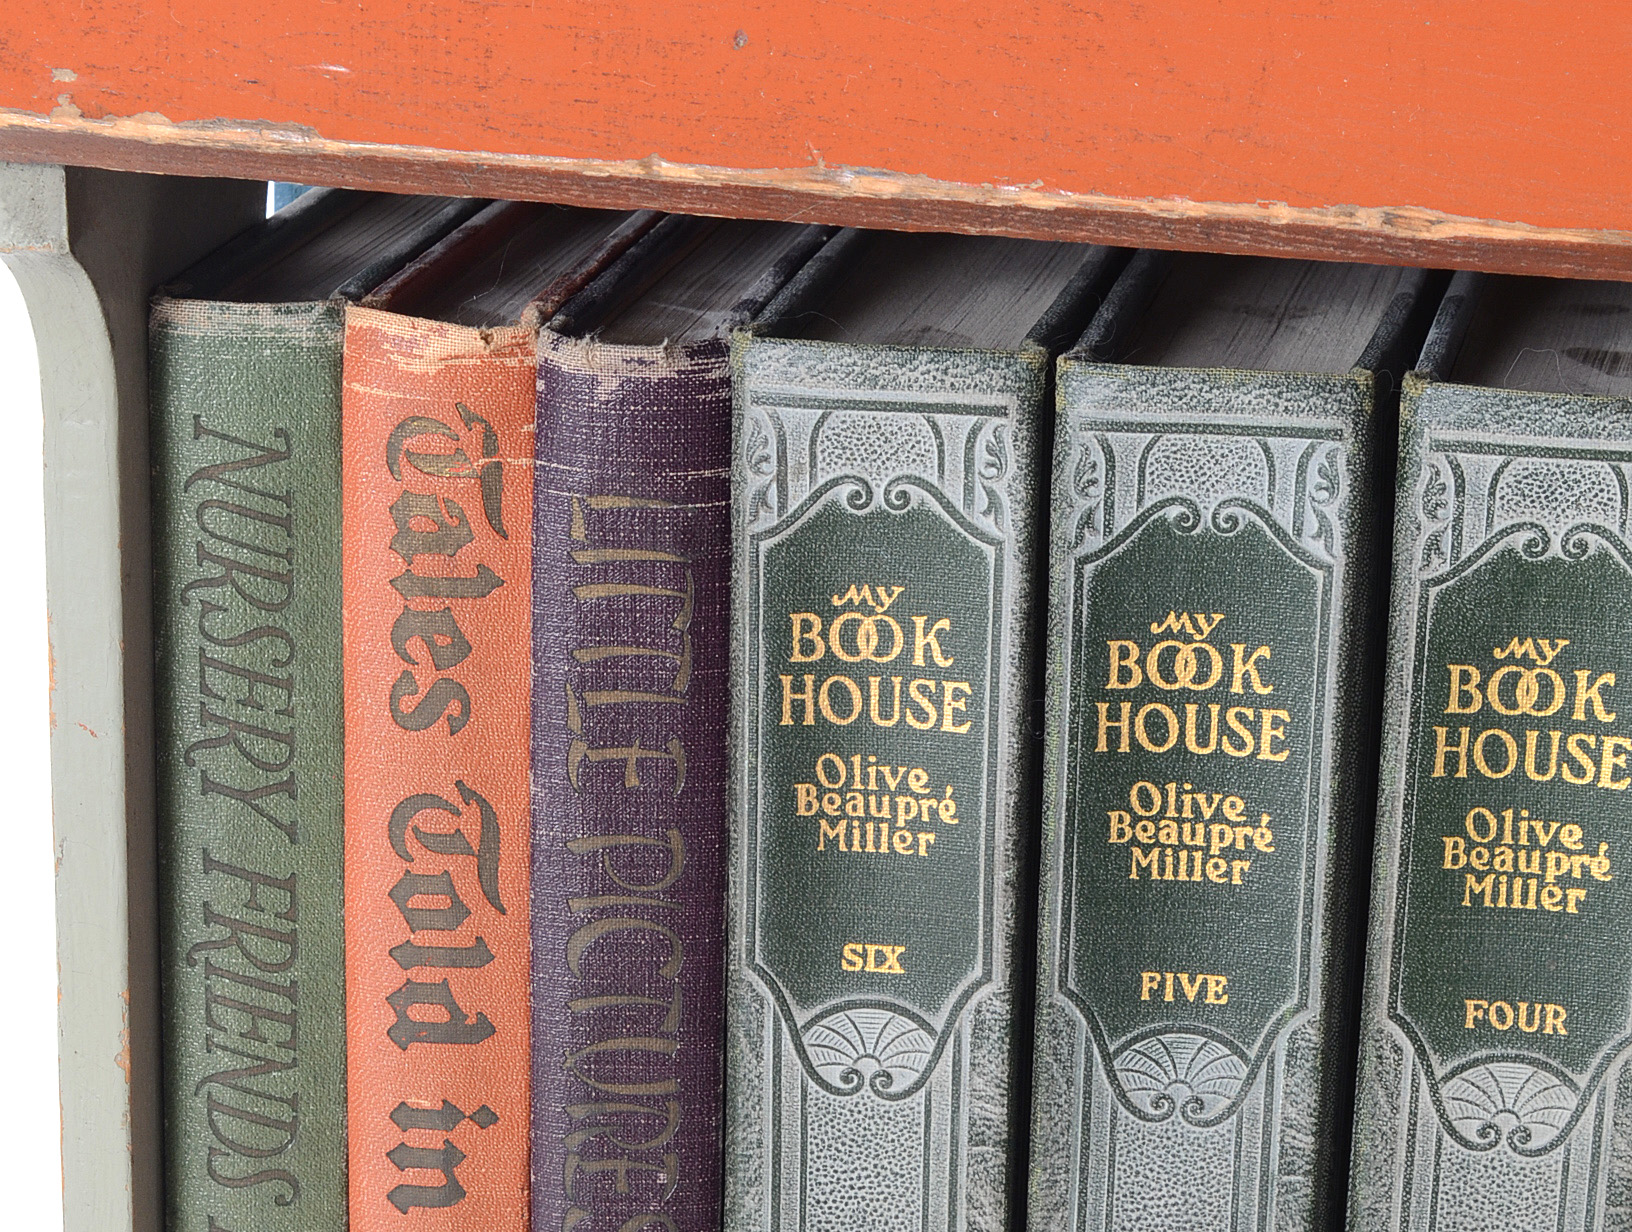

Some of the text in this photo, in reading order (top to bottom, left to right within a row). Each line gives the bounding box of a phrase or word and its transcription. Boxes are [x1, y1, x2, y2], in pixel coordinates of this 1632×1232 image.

[385, 402, 510, 737] Tales
[183, 414, 298, 844] NURSERY
[565, 490, 695, 796] LITTLE
[789, 612, 954, 666] BOOK
[1106, 640, 1273, 694] BOOK
[780, 674, 972, 733] HOUSE
[1444, 664, 1616, 722] BOOK
[1095, 702, 1290, 761] HOUSE
[816, 753, 931, 793] Olive
[1432, 726, 1632, 790] HOUSE
[794, 783, 959, 826] Beaupré
[1130, 781, 1246, 821] Olive
[818, 819, 935, 856] Miller
[1108, 811, 1274, 854] Beaupré
[1465, 807, 1583, 850] Olive
[1130, 847, 1250, 884] Miller
[1442, 837, 1612, 883] Beaupré
[384, 780, 506, 1051] Told
[1462, 874, 1586, 913] Miller
[841, 943, 905, 974] SIX
[1141, 972, 1228, 1004] FIVE
[188, 847, 300, 1207] FRIENDS
[1465, 1000, 1567, 1034] FOUR
[385, 1098, 500, 1216] in
